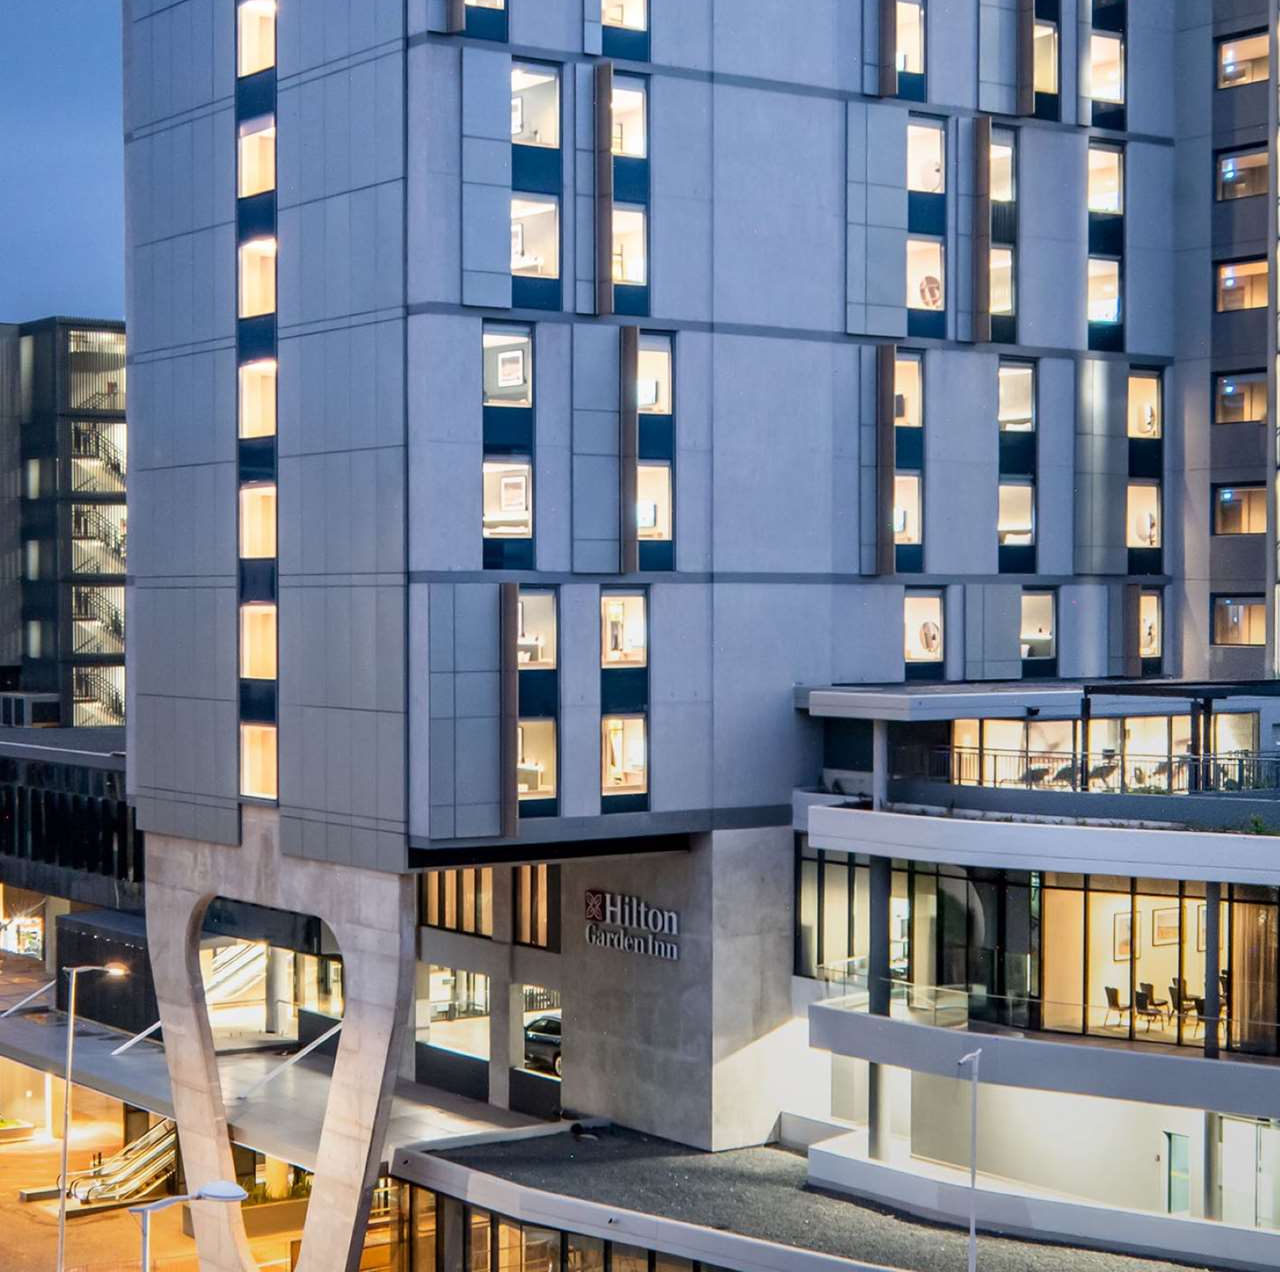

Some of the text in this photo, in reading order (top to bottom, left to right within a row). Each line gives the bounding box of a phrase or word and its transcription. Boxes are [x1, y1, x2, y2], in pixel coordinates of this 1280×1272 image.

[605, 893, 678, 935] Hilton
[585, 924, 678, 960] Garden Inn
